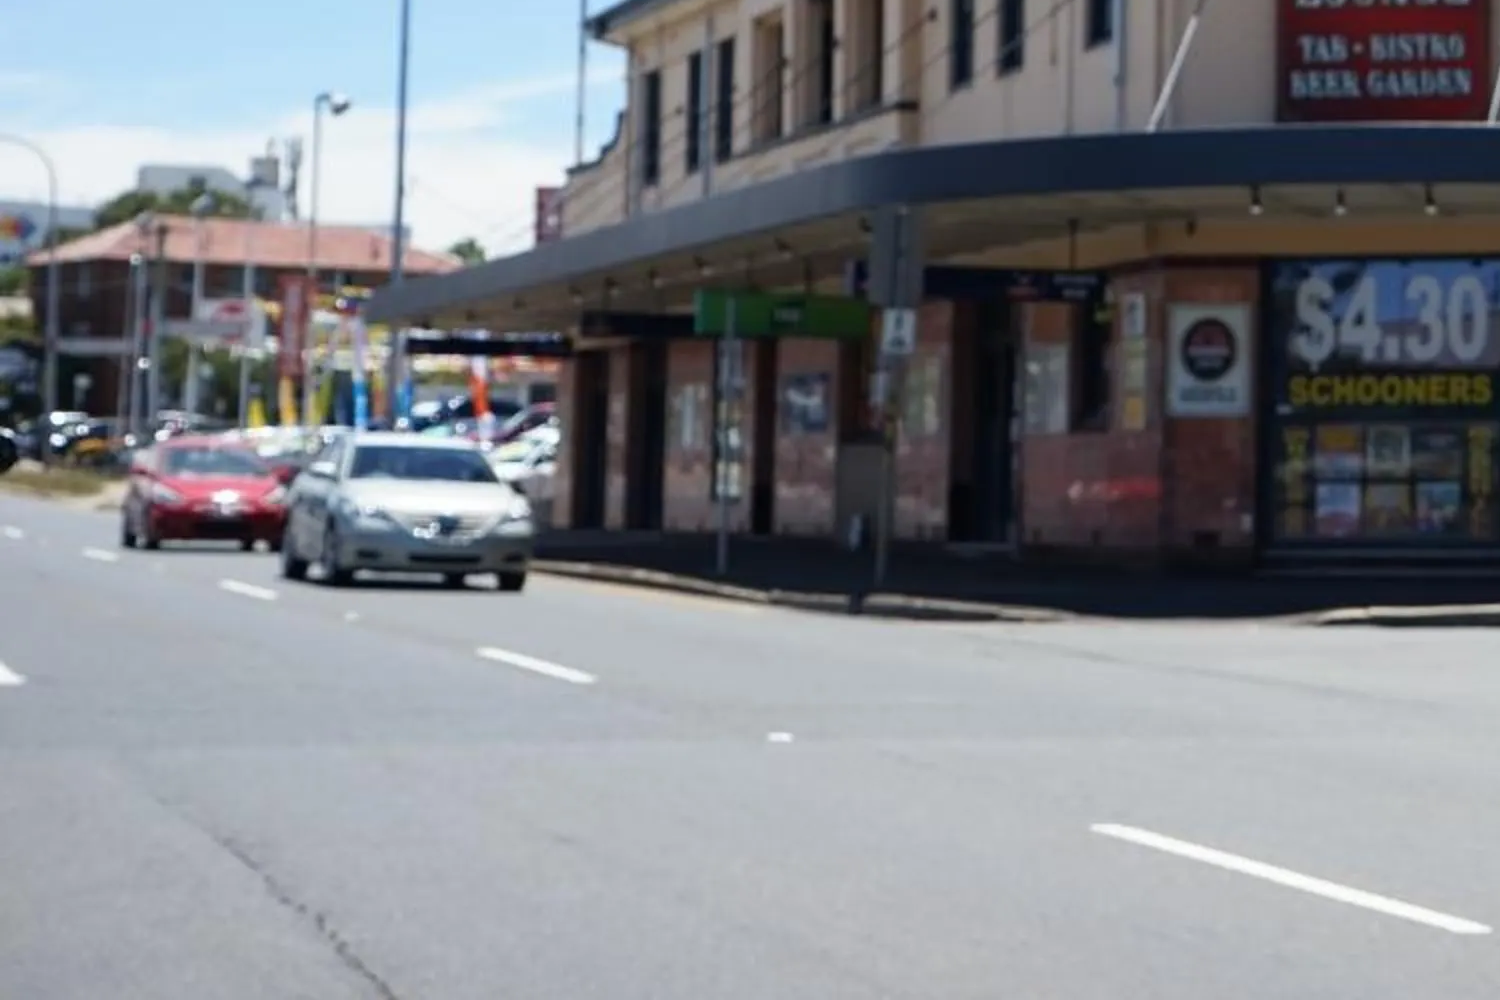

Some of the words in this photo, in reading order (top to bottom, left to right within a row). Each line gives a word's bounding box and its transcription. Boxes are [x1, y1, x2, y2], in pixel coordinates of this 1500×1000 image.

[1298, 34, 1348, 63] TAB
[1369, 33, 1465, 61] BISTRO
[1290, 69, 1361, 98] BEER
[1366, 68, 1472, 97] GARDEN
[1291, 271, 1490, 371] $4.30
[1289, 374, 1492, 406] SCHOONERS
